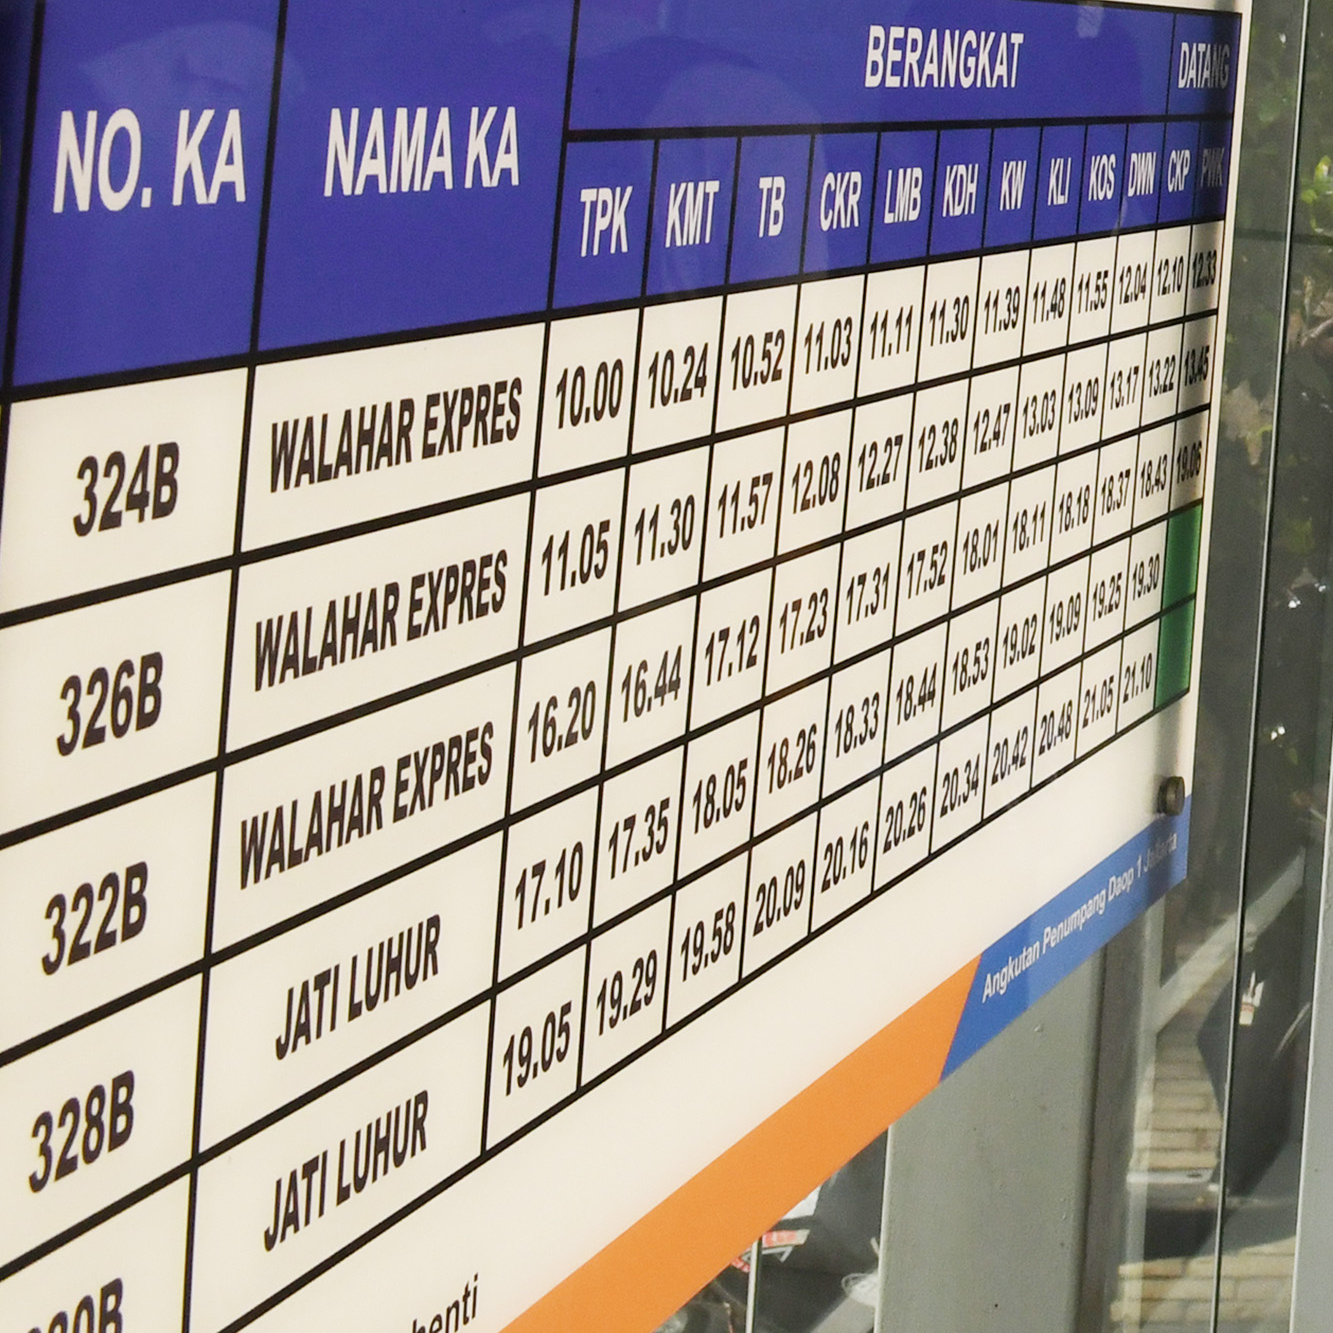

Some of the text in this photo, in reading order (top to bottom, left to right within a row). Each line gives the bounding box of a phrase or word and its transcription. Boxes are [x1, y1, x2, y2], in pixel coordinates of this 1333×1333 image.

[864, 25, 1024, 88] BERANGKAT
[1177, 42, 1230, 89] DATANG
[52, 106, 520, 214] NO. KA NAMA KA
[580, 153, 1116, 257] TPK KMT TB CKR LMB KDH KW KLI KOS
[72, 342, 709, 539] 324B WALAHAR EXPRES 10.00 10.24
[57, 520, 611, 757] 326B WALAHAR EXPRES 11.05
[41, 679, 597, 977] 322B WALAHAR EXPRES 16.20
[28, 839, 586, 1194] 328B JATI LUHUR 17.10
[982, 939, 1041, 1004] Angkutan
[1042, 887, 1107, 956] Penumpang
[1108, 865, 1135, 903] Daop
[263, 1002, 573, 1252] JATI LUHUR 19.05
